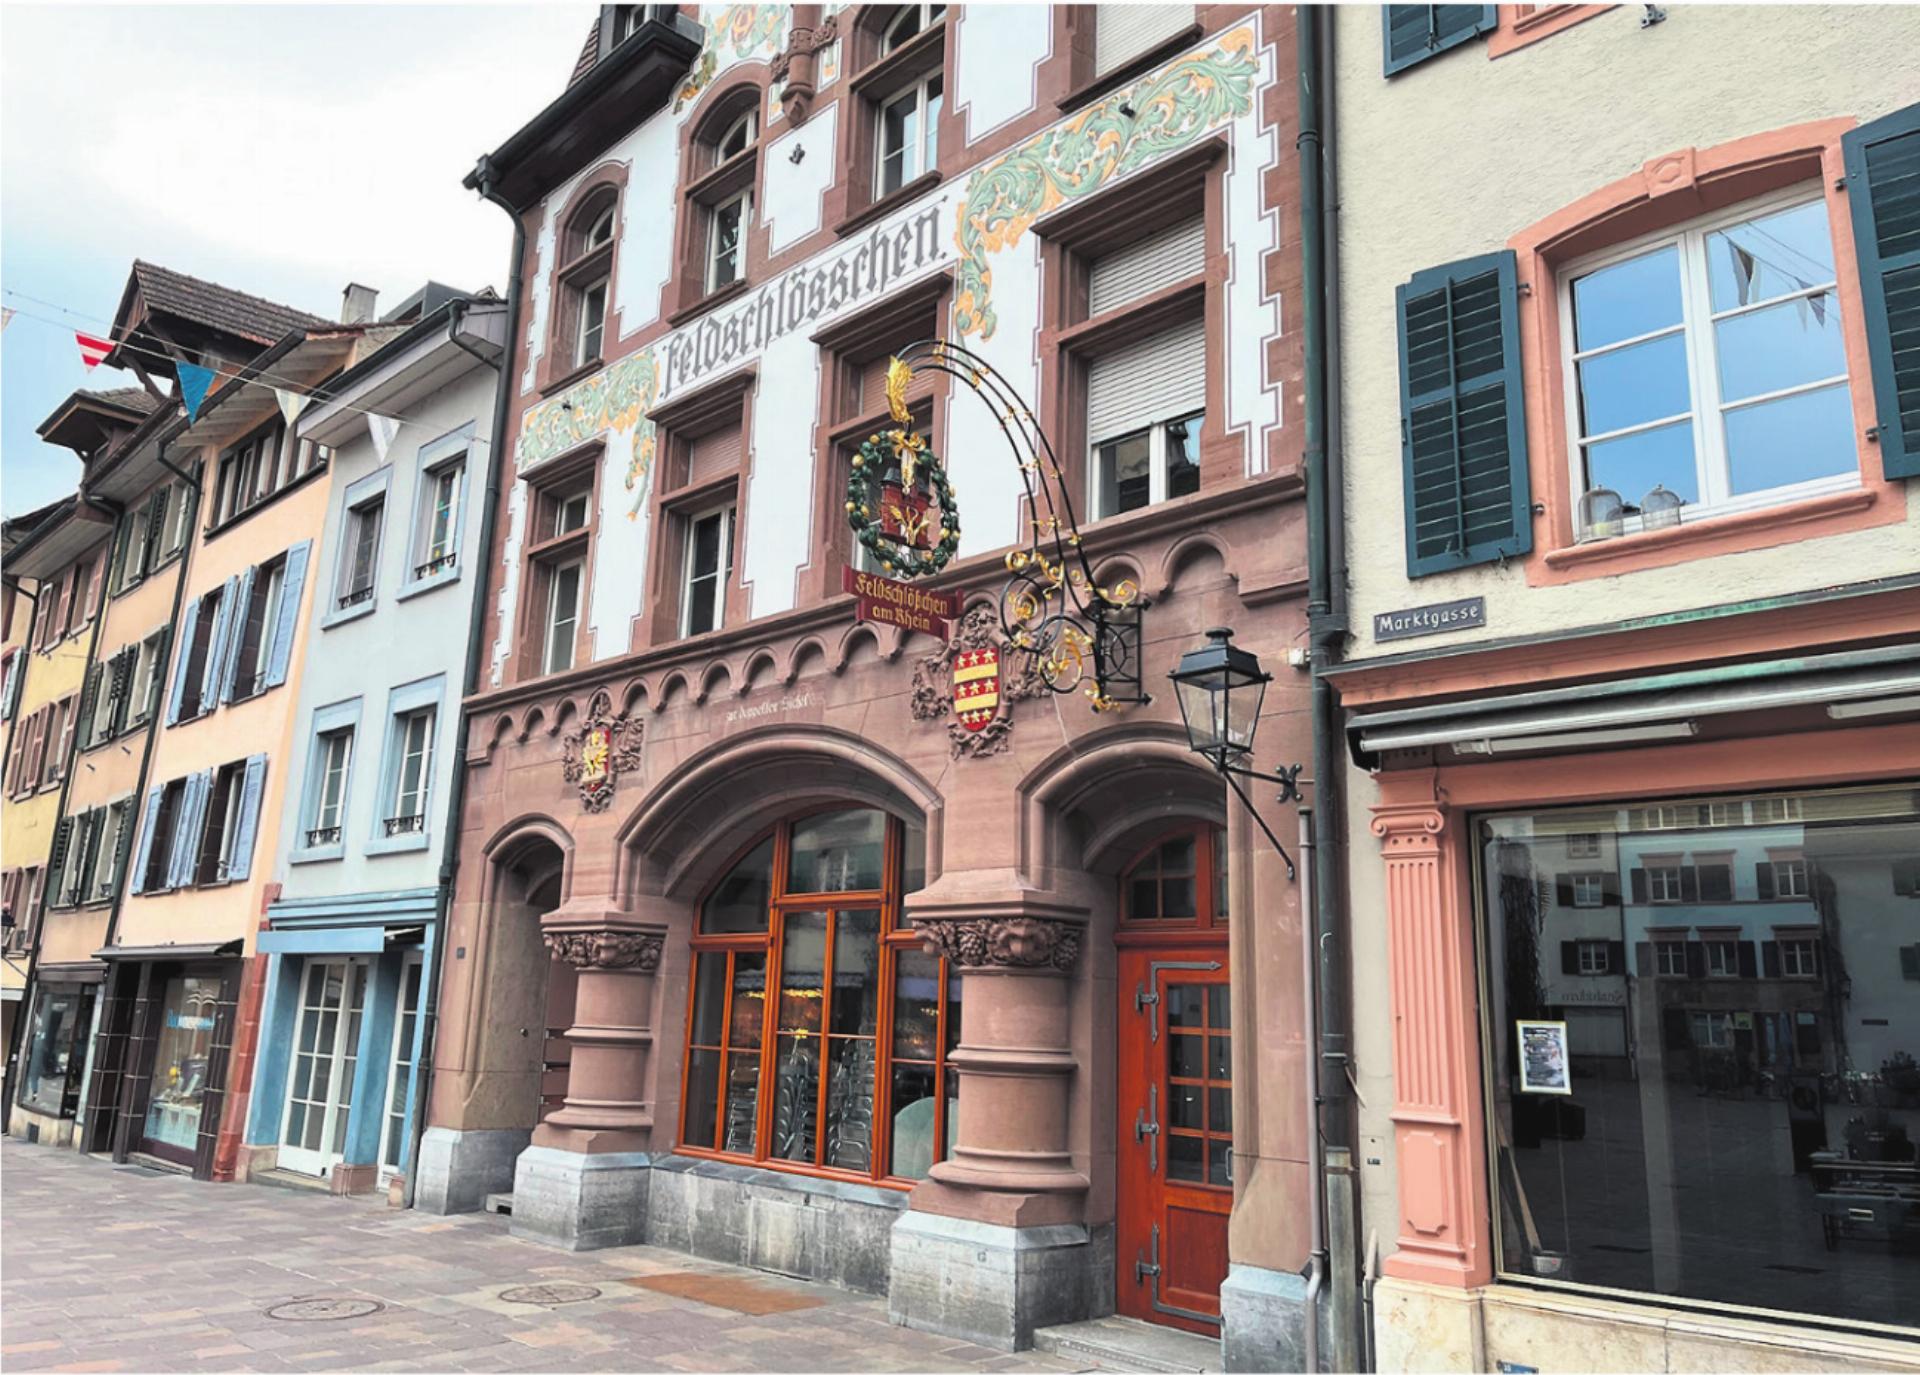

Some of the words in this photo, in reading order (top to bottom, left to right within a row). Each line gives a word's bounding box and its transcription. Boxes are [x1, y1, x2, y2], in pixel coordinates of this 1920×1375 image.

[872, 605, 893, 620] am
[895, 607, 930, 630] Rhein
[1380, 606, 1478, 632] Marktgasse
